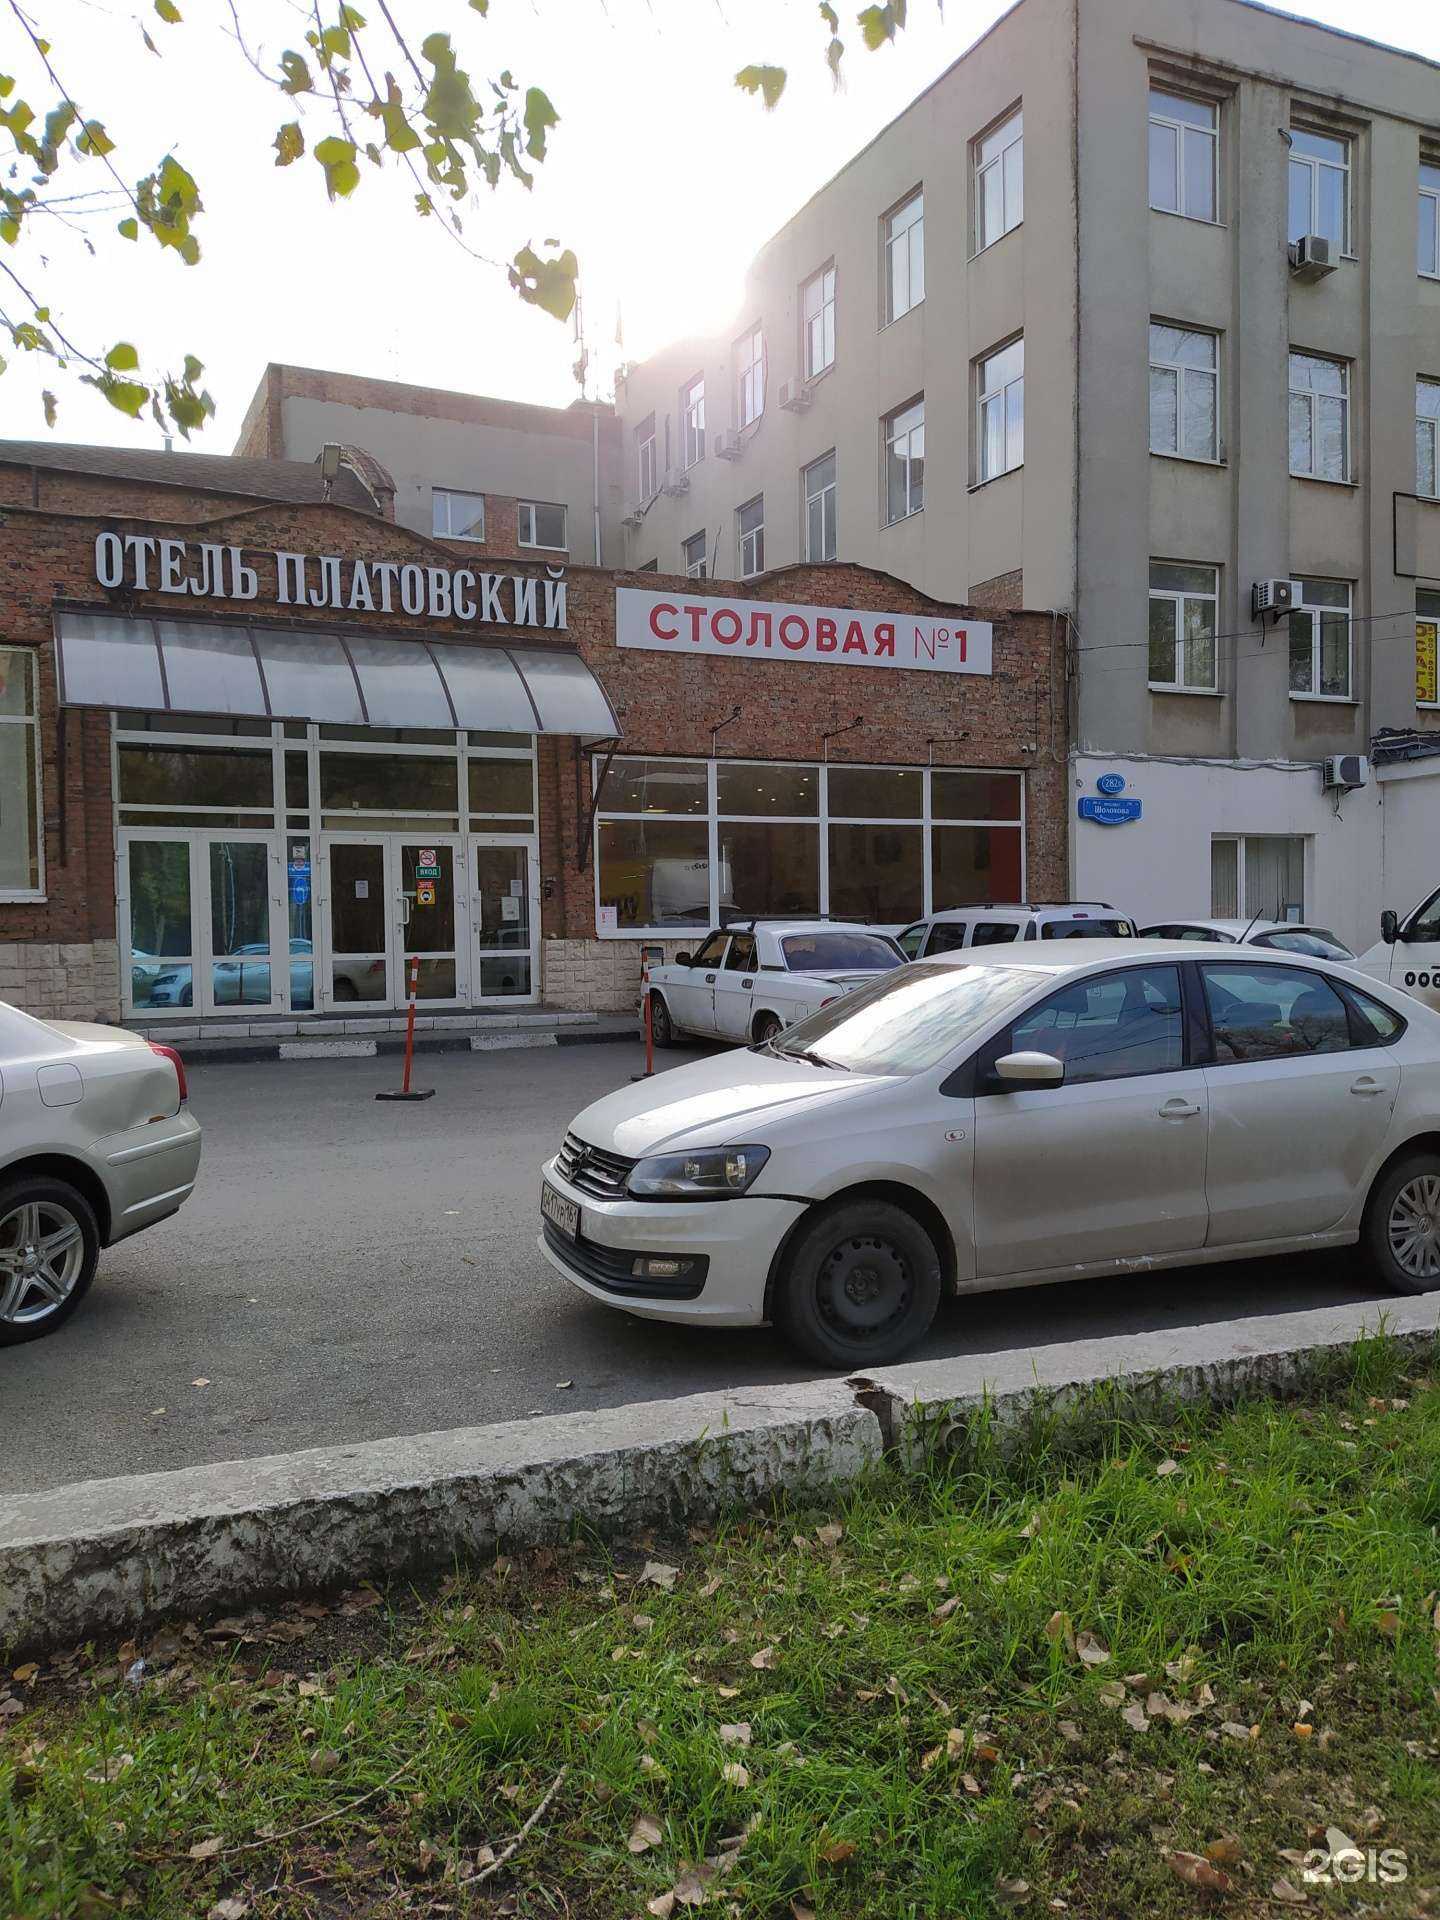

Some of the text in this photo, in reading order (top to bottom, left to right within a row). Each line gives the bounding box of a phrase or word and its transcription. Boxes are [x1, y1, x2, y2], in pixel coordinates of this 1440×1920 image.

[95, 532, 569, 630] ОТЕЛЬ ПЛАТОВСКИЙ
[649, 603, 968, 663] СТОЛОВАЯ №1
